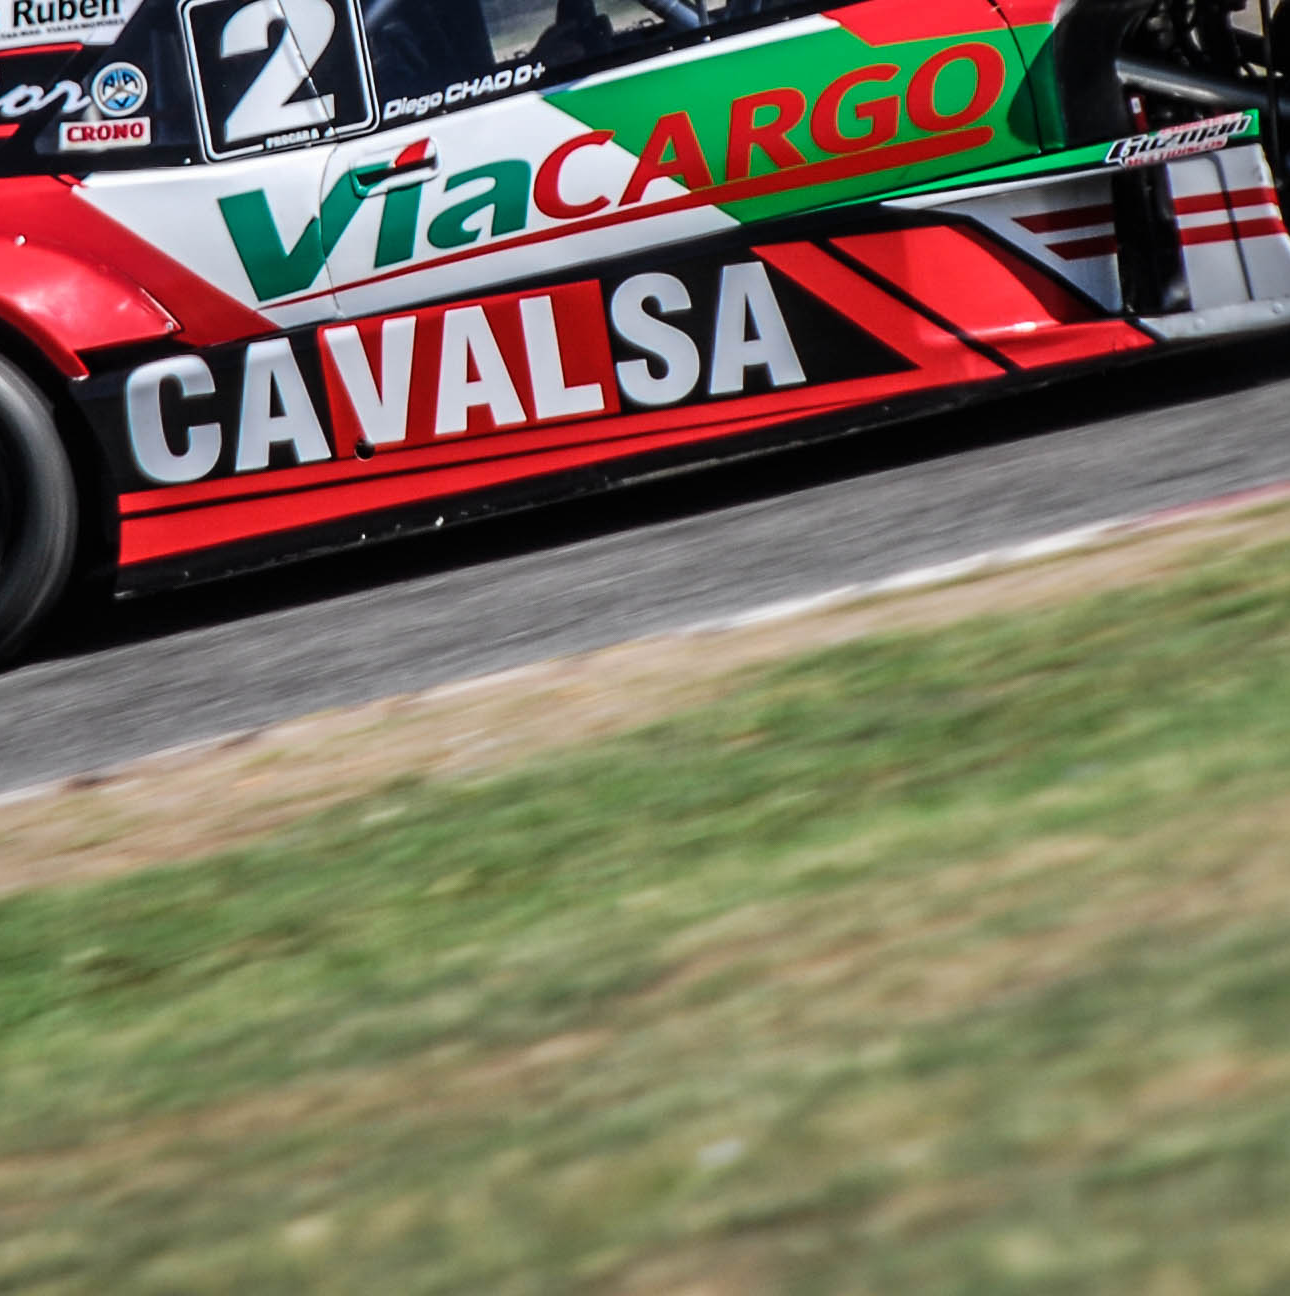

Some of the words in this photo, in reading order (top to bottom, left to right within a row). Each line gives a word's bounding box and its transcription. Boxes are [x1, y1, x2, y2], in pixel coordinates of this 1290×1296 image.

[383, 92, 443, 120] Diego
[66, 122, 145, 143] CRONO
[126, 260, 807, 484] CAVALSA
